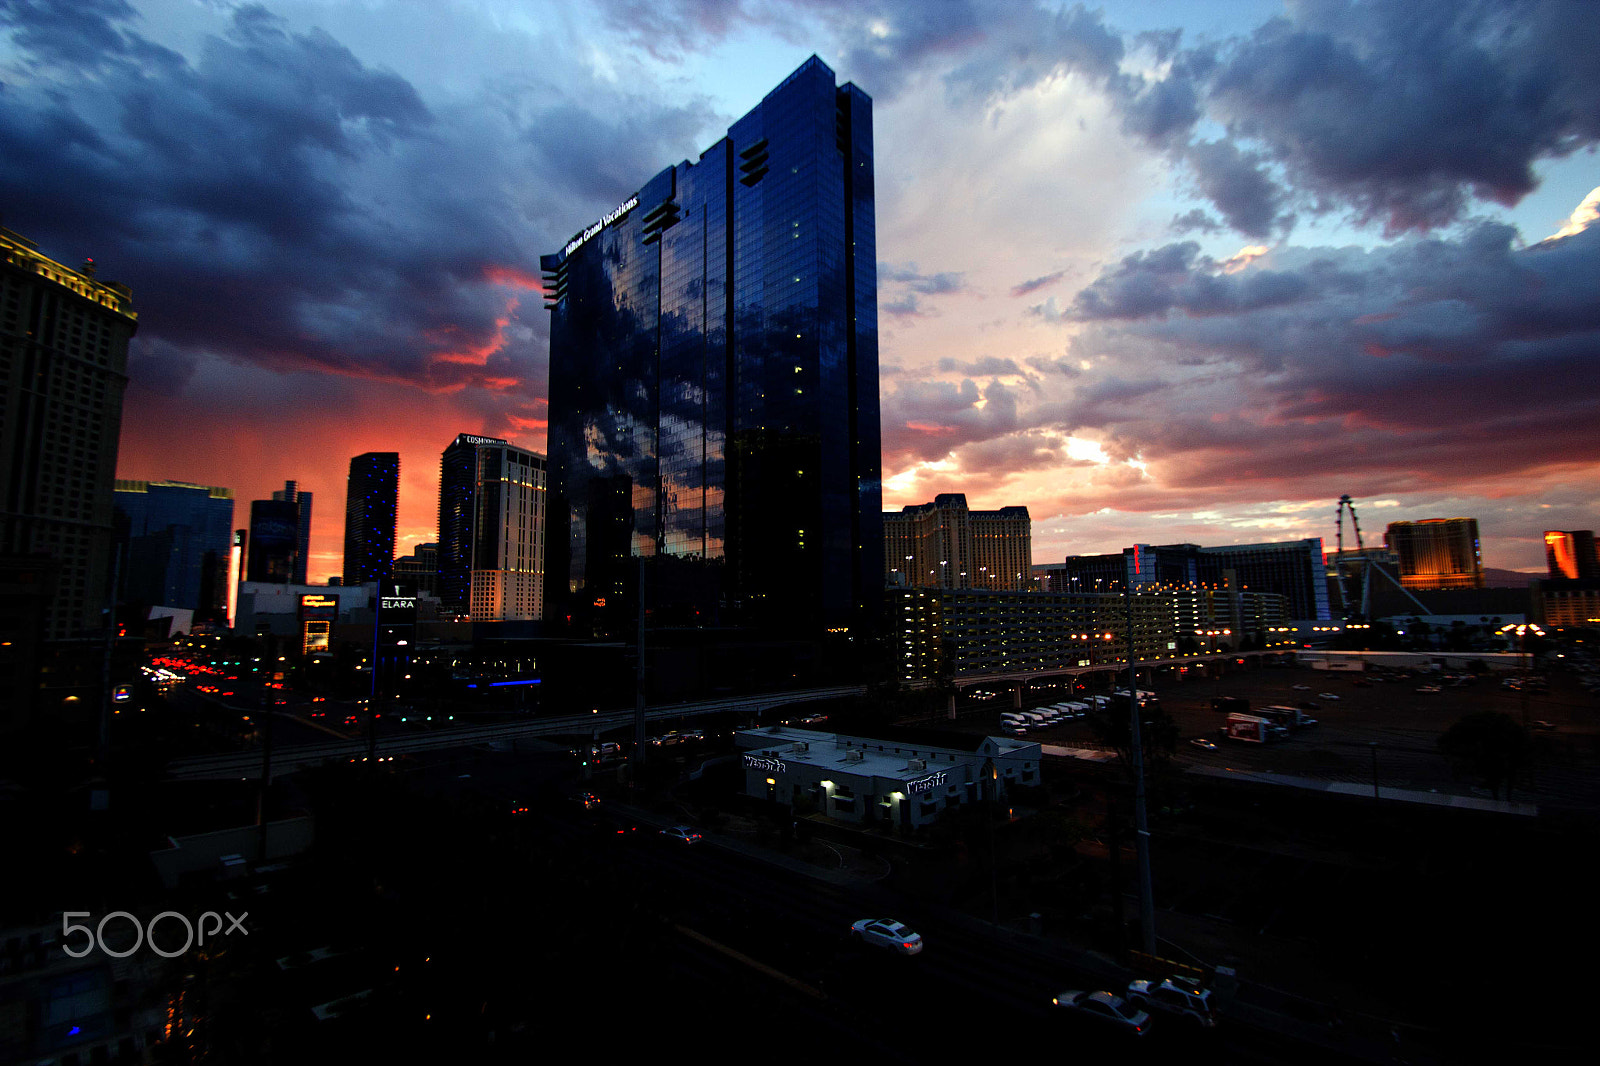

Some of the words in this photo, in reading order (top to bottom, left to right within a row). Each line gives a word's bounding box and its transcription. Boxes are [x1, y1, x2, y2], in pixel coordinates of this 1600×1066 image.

[583, 219, 602, 242] Grand
[602, 195, 638, 227] Vacations
[382, 600, 414, 609] ELARA
